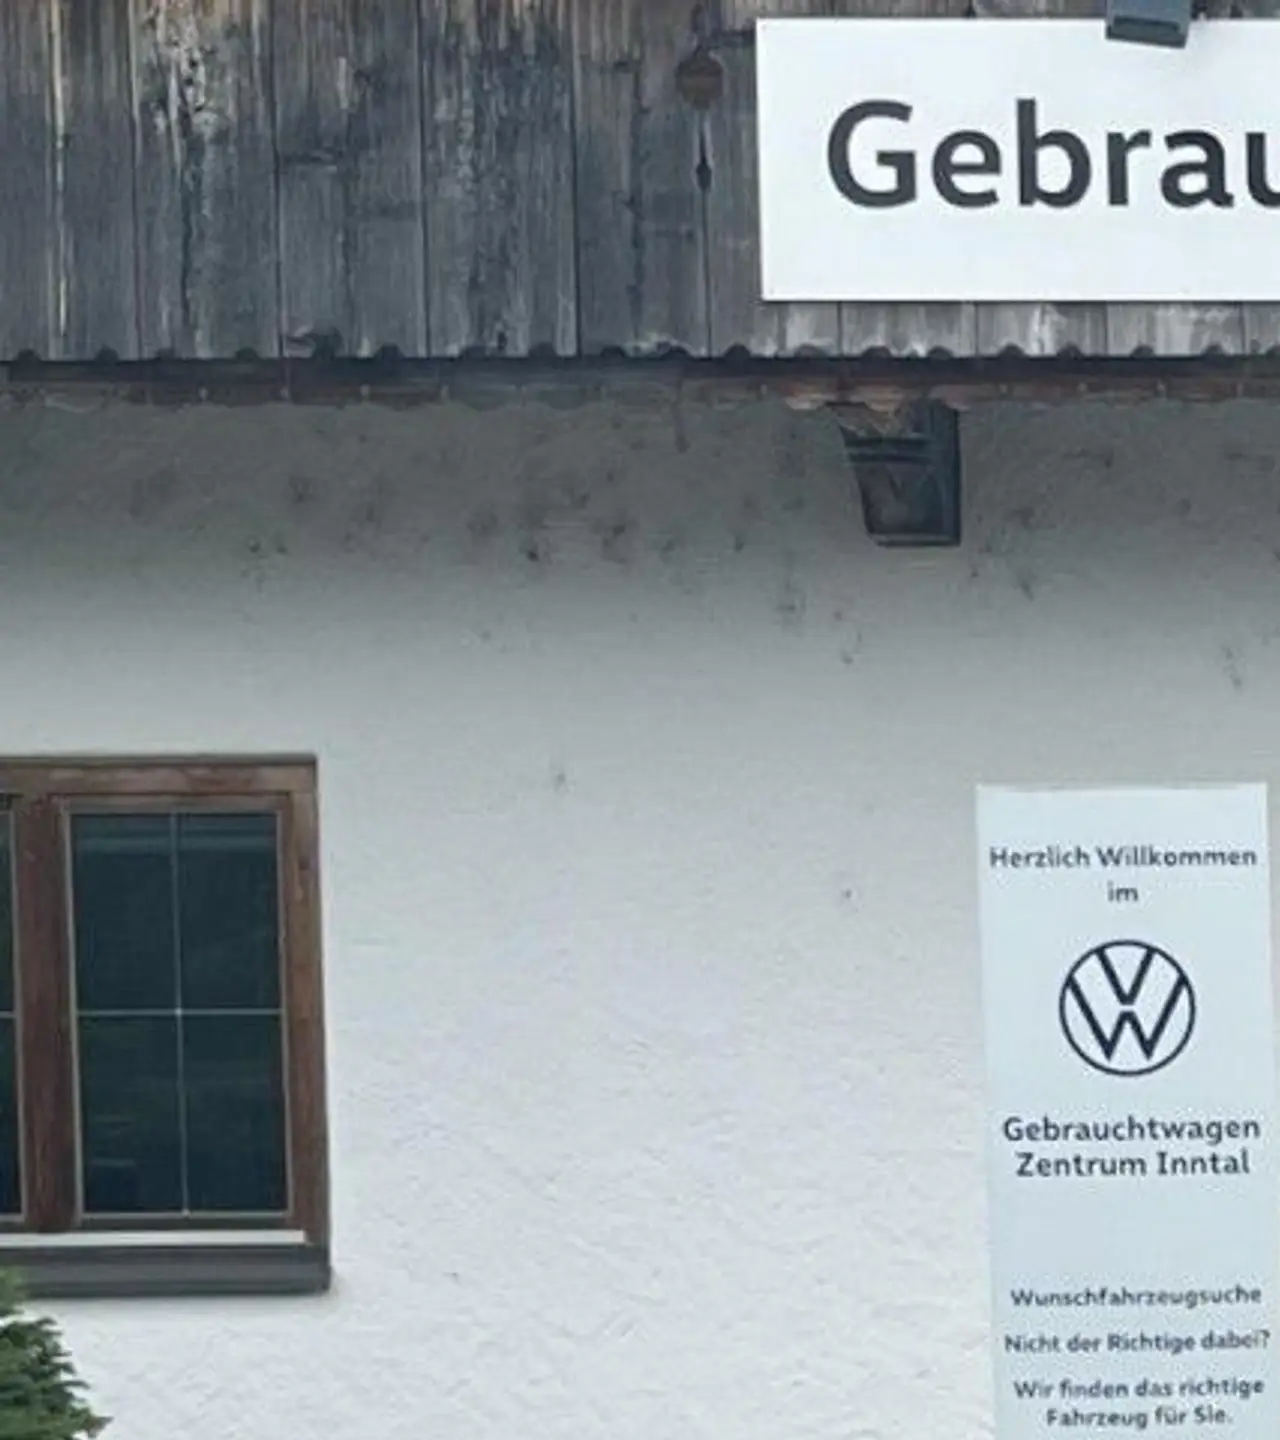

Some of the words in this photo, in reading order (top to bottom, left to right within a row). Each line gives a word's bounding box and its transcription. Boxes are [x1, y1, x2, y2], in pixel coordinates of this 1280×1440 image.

[989, 845, 1091, 869] Herzlich
[1095, 844, 1258, 868] Willkommen
[1106, 880, 1139, 903] im
[1059, 940, 1196, 1077] VW
[1001, 1114, 1261, 1147] Gebrauchtwagen
[1015, 1150, 1148, 1178] Zentrum
[1155, 1144, 1250, 1176] Inntal
[1009, 1283, 1262, 1310] Wunschfahrzeugsuche
[1004, 1332, 1061, 1355] Nicht
[1066, 1331, 1102, 1354] der
[1106, 1329, 1195, 1357] Richtige
[1200, 1328, 1271, 1354] dabei?
[1012, 1379, 1054, 1400] Wir
[1059, 1377, 1130, 1401] finden
[1134, 1376, 1173, 1399] das
[1178, 1375, 1265, 1402] richtige
[1046, 1406, 1149, 1433] Fahrzeug
[1154, 1405, 1188, 1427] für
[1193, 1404, 1232, 1427] Sie.
